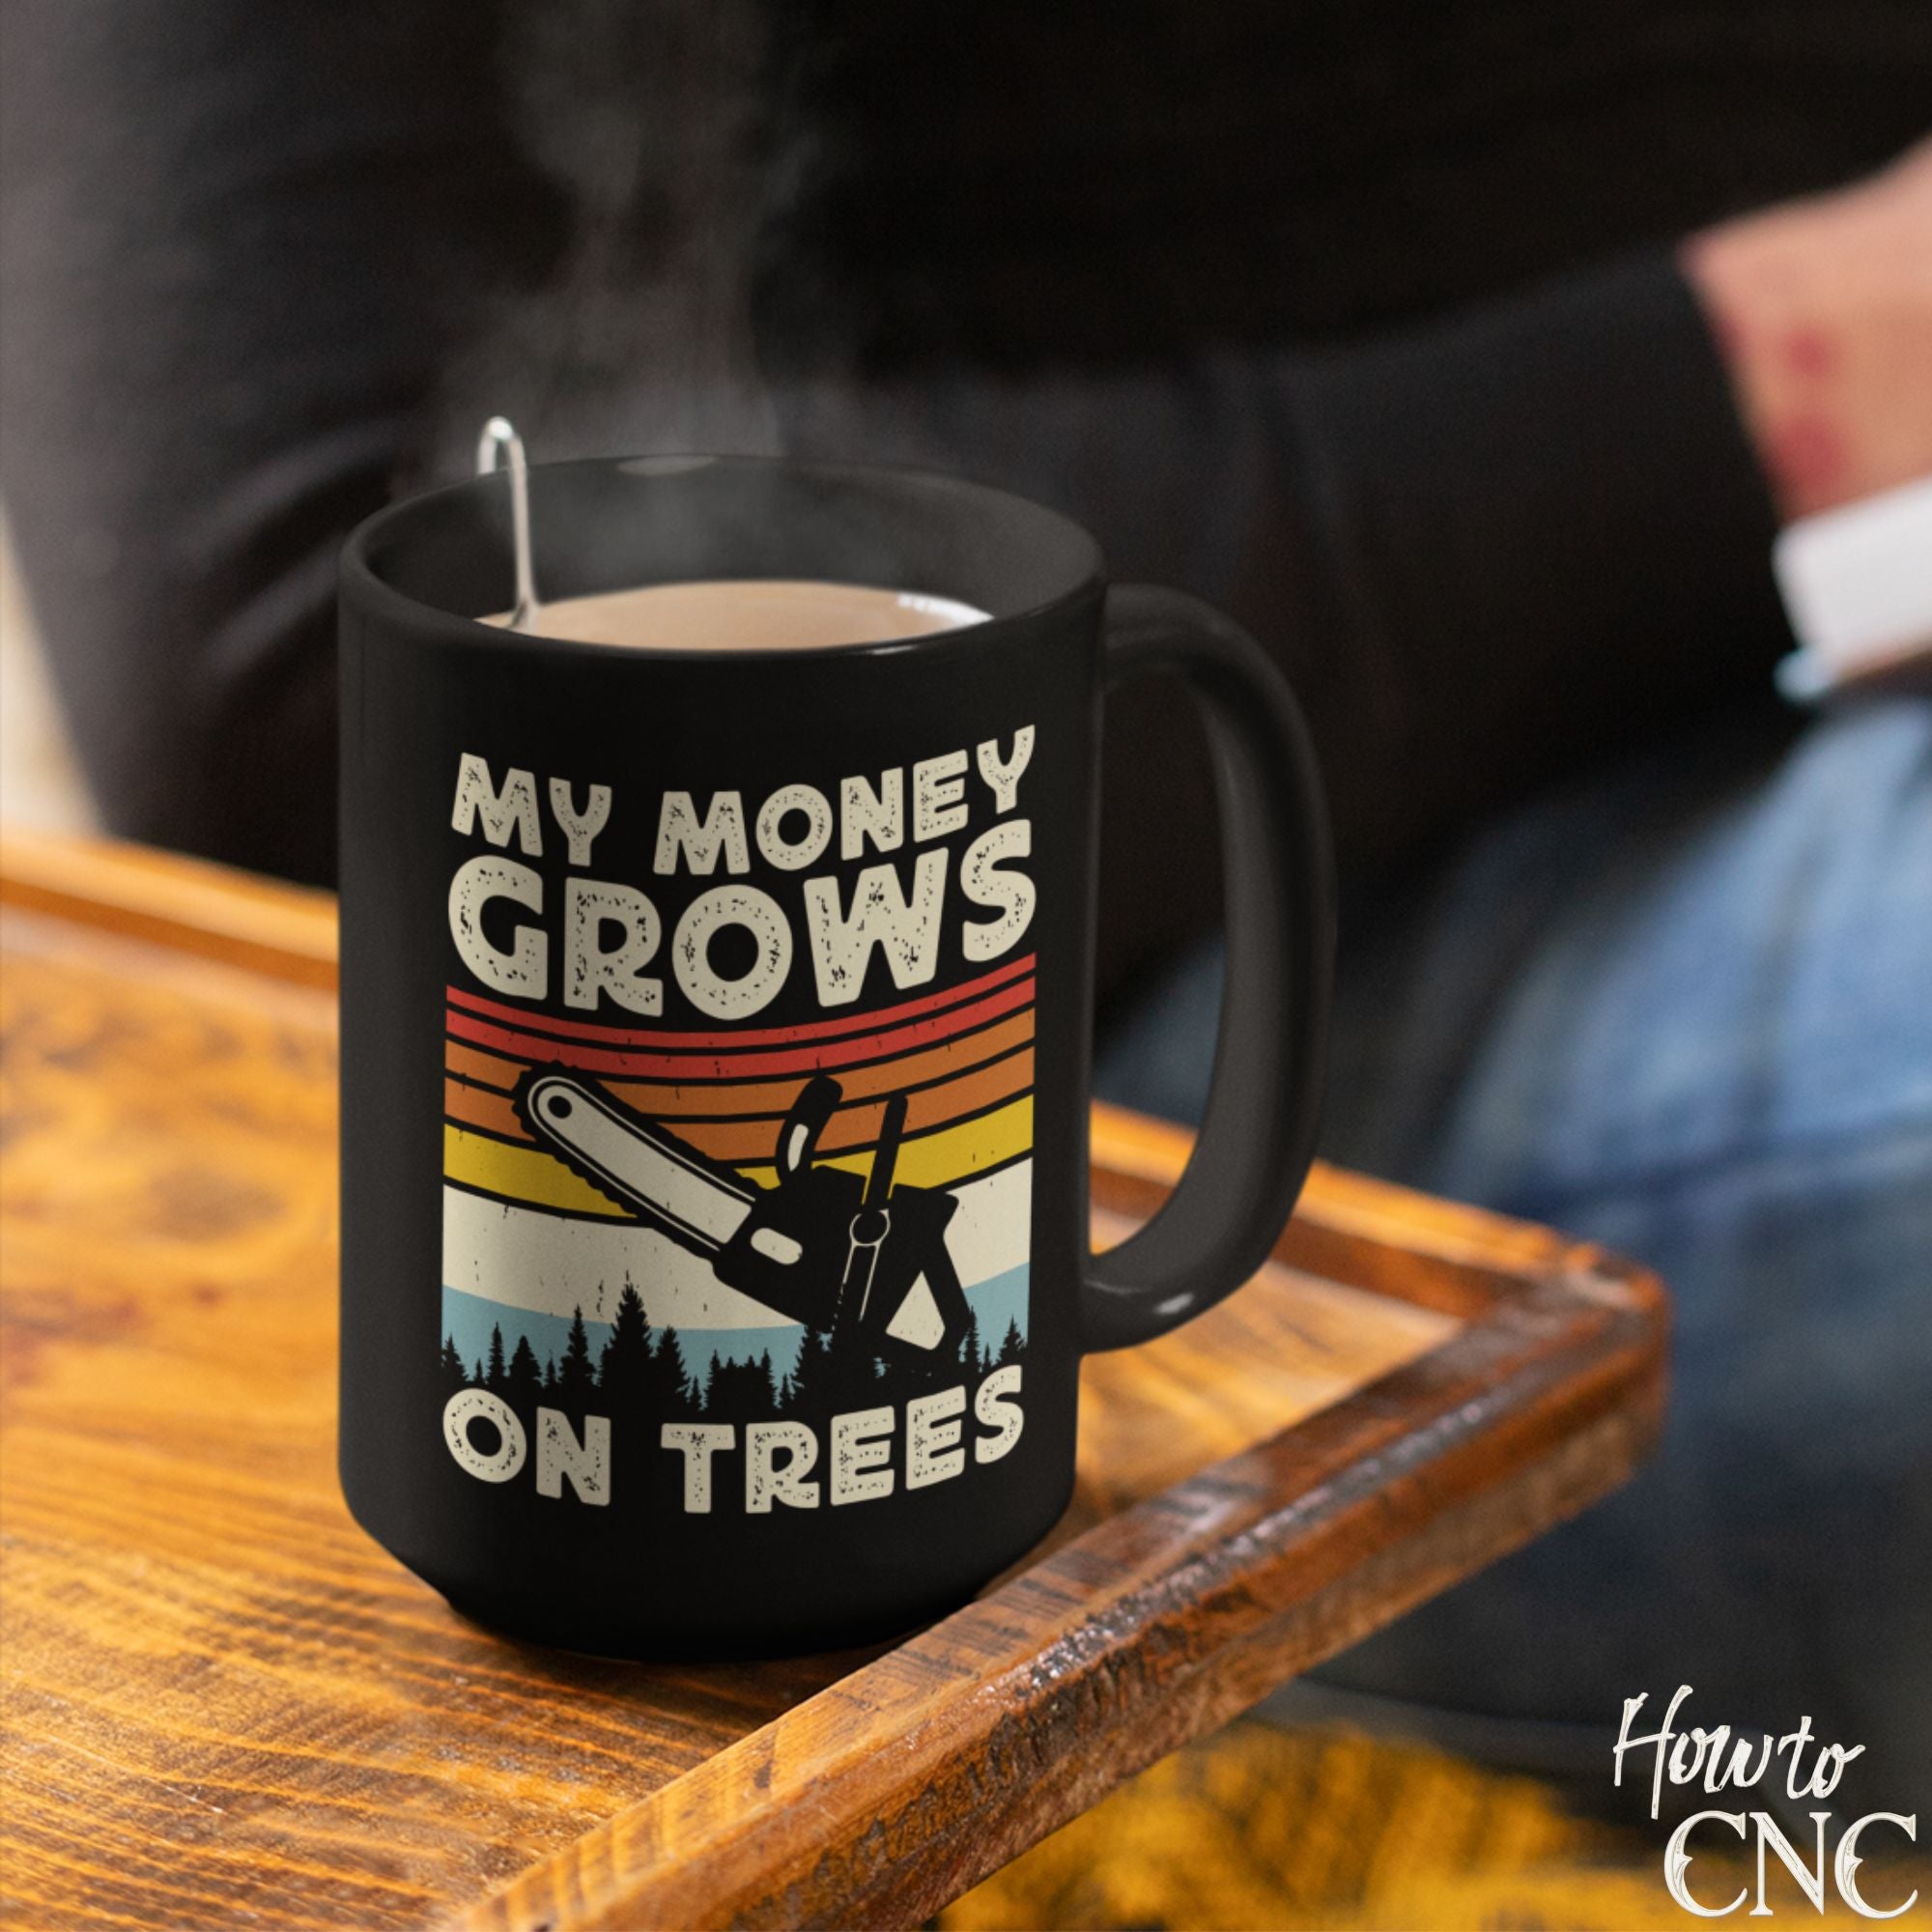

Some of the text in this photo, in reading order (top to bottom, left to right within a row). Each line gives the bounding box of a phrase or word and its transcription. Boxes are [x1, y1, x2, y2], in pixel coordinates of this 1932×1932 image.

[451, 724, 1036, 875] MY MONEY
[448, 819, 1037, 1021] GROWS
[442, 1364, 1024, 1514] ON TREES
